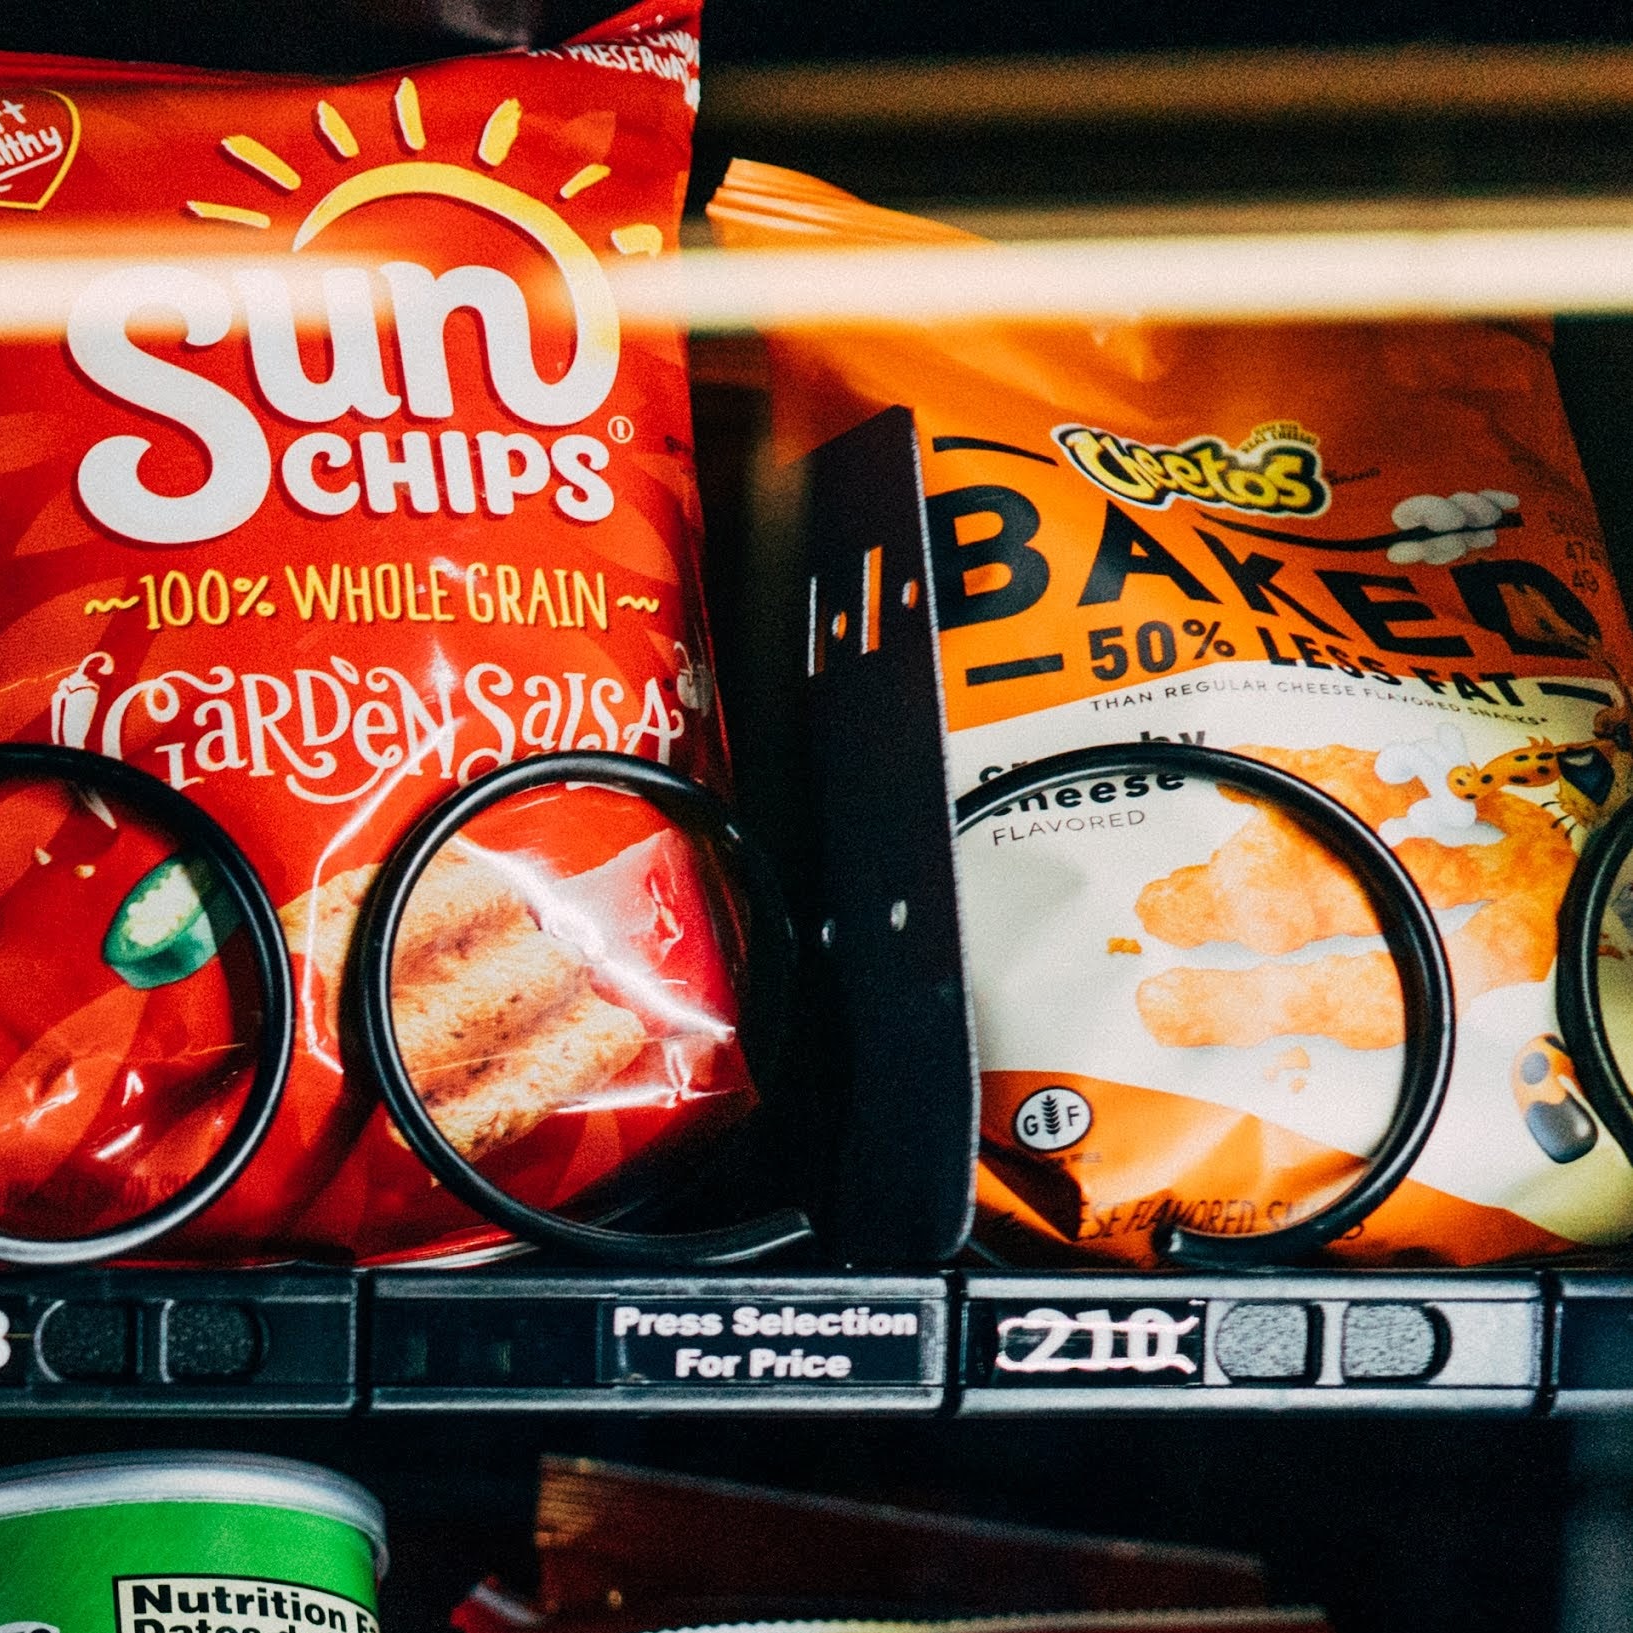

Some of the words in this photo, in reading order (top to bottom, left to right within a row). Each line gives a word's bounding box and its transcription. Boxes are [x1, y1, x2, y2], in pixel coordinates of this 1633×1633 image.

[68, 258, 619, 545] Sun
[282, 430, 615, 524] CHIPS
[1070, 428, 1317, 510] Cheetos
[139, 569, 275, 630] 100%
[285, 563, 455, 624] WHOLE
[466, 563, 608, 630] GRAIN
[936, 484, 1595, 662] BAKED
[1090, 618, 1237, 684] 50%
[1257, 626, 1403, 686] LESS
[1409, 665, 1531, 710] FAT
[1091, 690, 1153, 712] THAN
[1165, 680, 1268, 699] REGULAR
[1278, 682, 1356, 698] CHEESE
[1363, 686, 1461, 715] FLAVORED
[992, 809, 1147, 846] FLAVORED
[612, 1308, 723, 1337] Press
[732, 1307, 918, 1337] Selection
[1019, 1307, 1185, 1374] 210
[675, 1348, 741, 1378] For
[749, 1348, 852, 1378] Price
[132, 1583, 347, 1633] Nutrition
